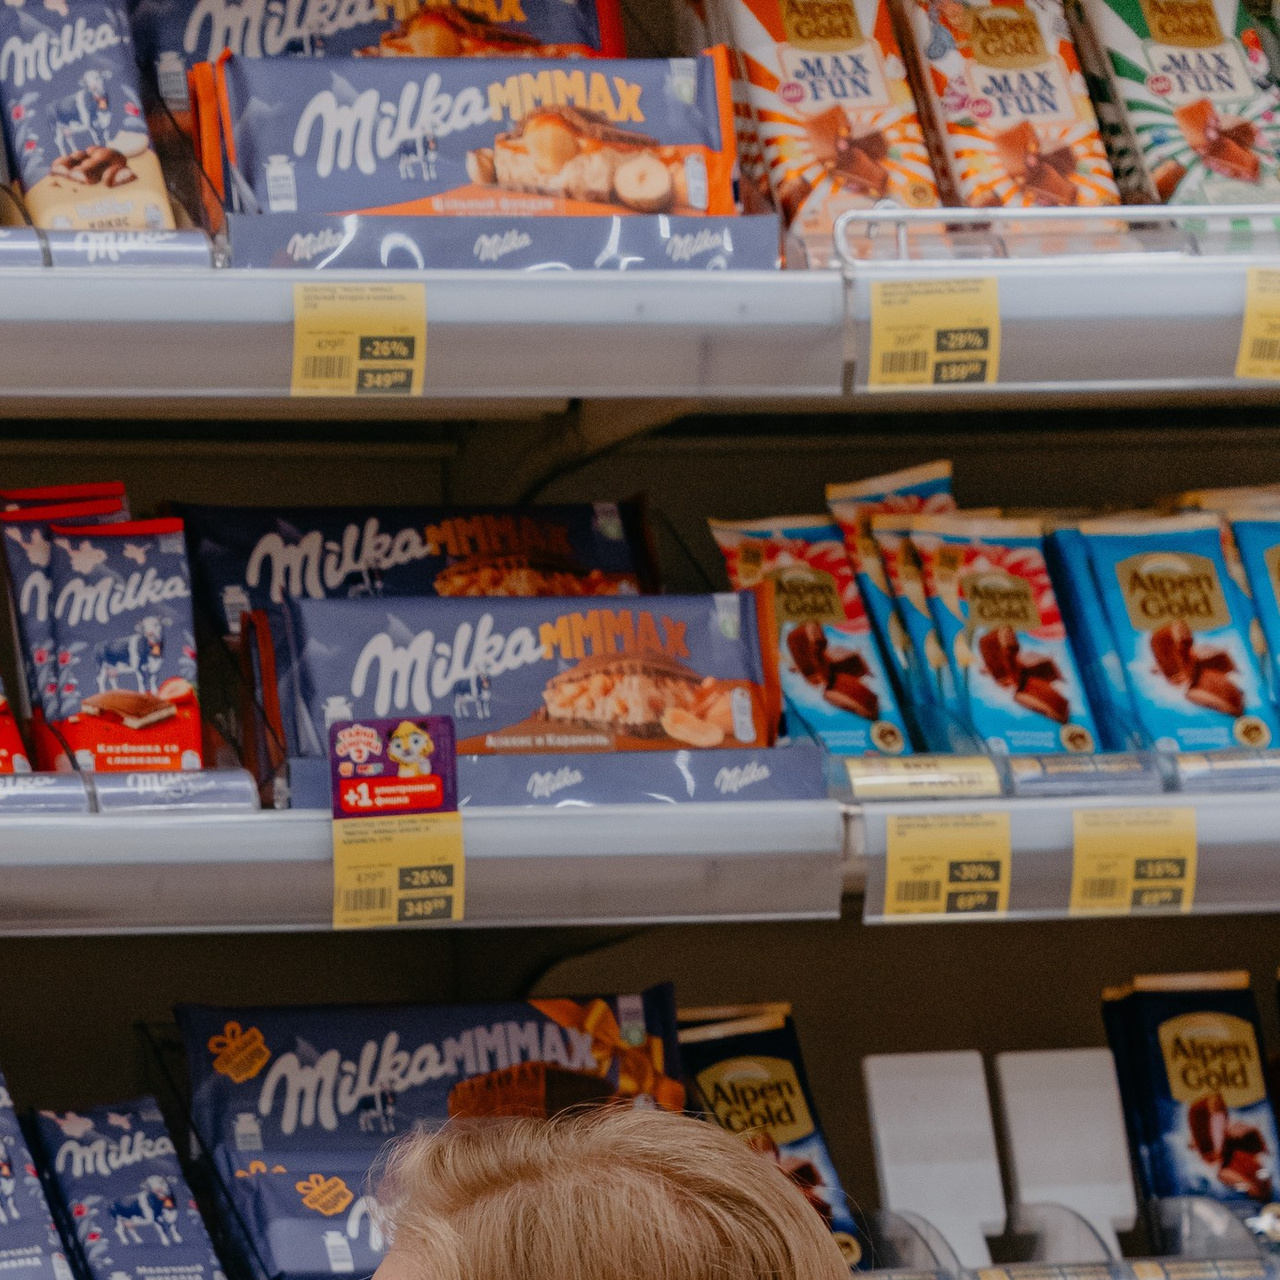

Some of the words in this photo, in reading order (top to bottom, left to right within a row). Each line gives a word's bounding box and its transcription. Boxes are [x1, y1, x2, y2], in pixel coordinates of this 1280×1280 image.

[0, 18, 126, 86] Milka
[1161, 50, 1233, 77] MAX
[792, 54, 868, 82] MAX
[981, 71, 1057, 96] MAX
[808, 77, 871, 101] FUN
[1172, 73, 1236, 97] FUN
[996, 91, 1059, 116] FUN
[291, 73, 498, 178] Milka
[486, 70, 646, 122] MMMAX
[285, 227, 342, 261] Milka
[472, 228, 533, 261] Milka
[666, 228, 723, 261] Milka
[245, 517, 430, 602] Milka
[54, 568, 190, 627] Milka
[1127, 570, 1215, 604] Alpen
[1140, 596, 1211, 622] Gold
[350, 613, 545, 718] Milka
[538, 608, 689, 664] MMMAX
[526, 766, 582, 796] Milka
[714, 762, 771, 794] Milka
[344, 783, 373, 806] +1
[1170, 1035, 1251, 1065] Alpen
[260, 1032, 442, 1135] Milka
[1180, 1061, 1247, 1092] Gold
[713, 1080, 795, 1111] Alpen
[724, 1101, 796, 1133] Gold
[55, 1131, 174, 1178] Milka
[136, 1264, 202, 1276] Молочный
